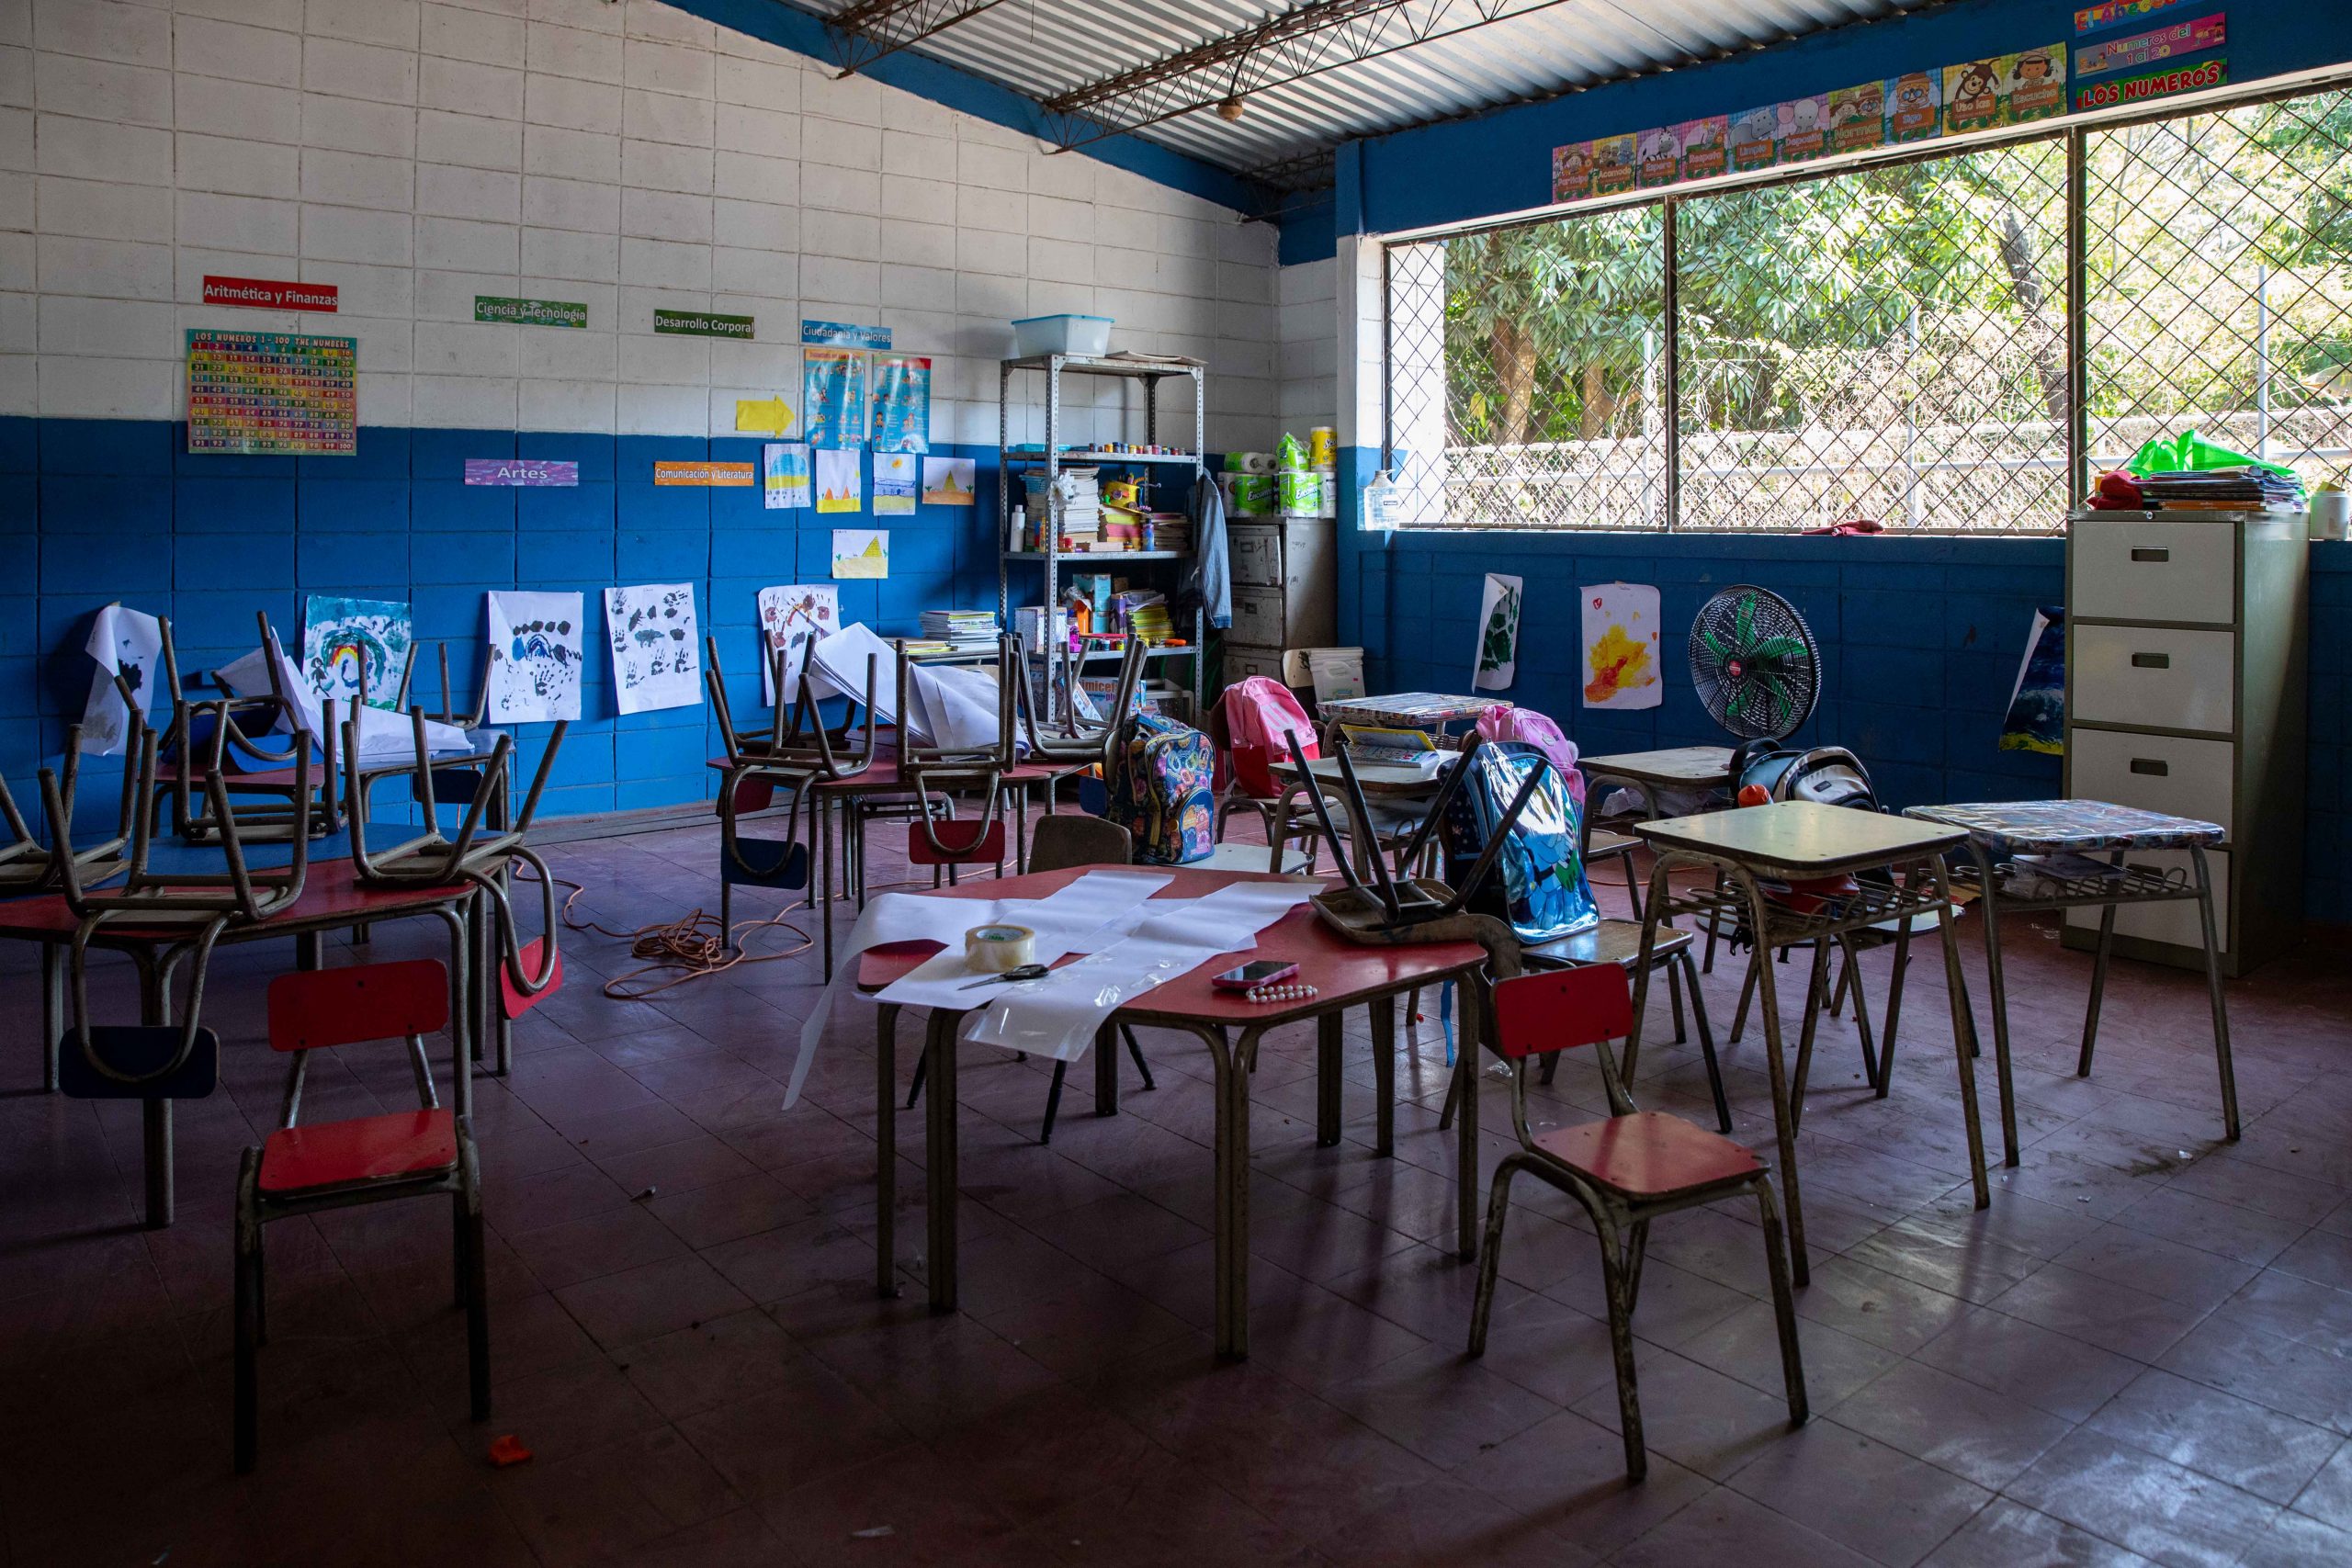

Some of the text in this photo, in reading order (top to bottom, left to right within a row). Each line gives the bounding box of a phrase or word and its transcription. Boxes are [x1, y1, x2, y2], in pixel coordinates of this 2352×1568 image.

[2075, 11, 2094, 31] El
[2107, 24, 2190, 56] Numeros del
[2127, 45, 2171, 65] 1 al 20
[2084, 64, 2219, 107] LOS NUMEROS
[1955, 102, 1973, 113] Uso
[205, 284, 338, 306] Aritmética y Finanzas
[476, 302, 585, 322] Ciencia y Tecnología
[655, 315, 754, 334] Desarrollo Corporal
[195, 333, 212, 341] LOS
[217, 333, 256, 343] NUMEROS
[261, 335, 265, 344] 1
[275, 336, 289, 344] 100
[295, 337, 310, 346] THE
[313, 339, 350, 348] NUMBERS
[853, 331, 859, 342] y
[860, 330, 891, 343] Valores
[497, 467, 548, 479] Artes
[655, 468, 753, 480] Comunicación y Literatura
